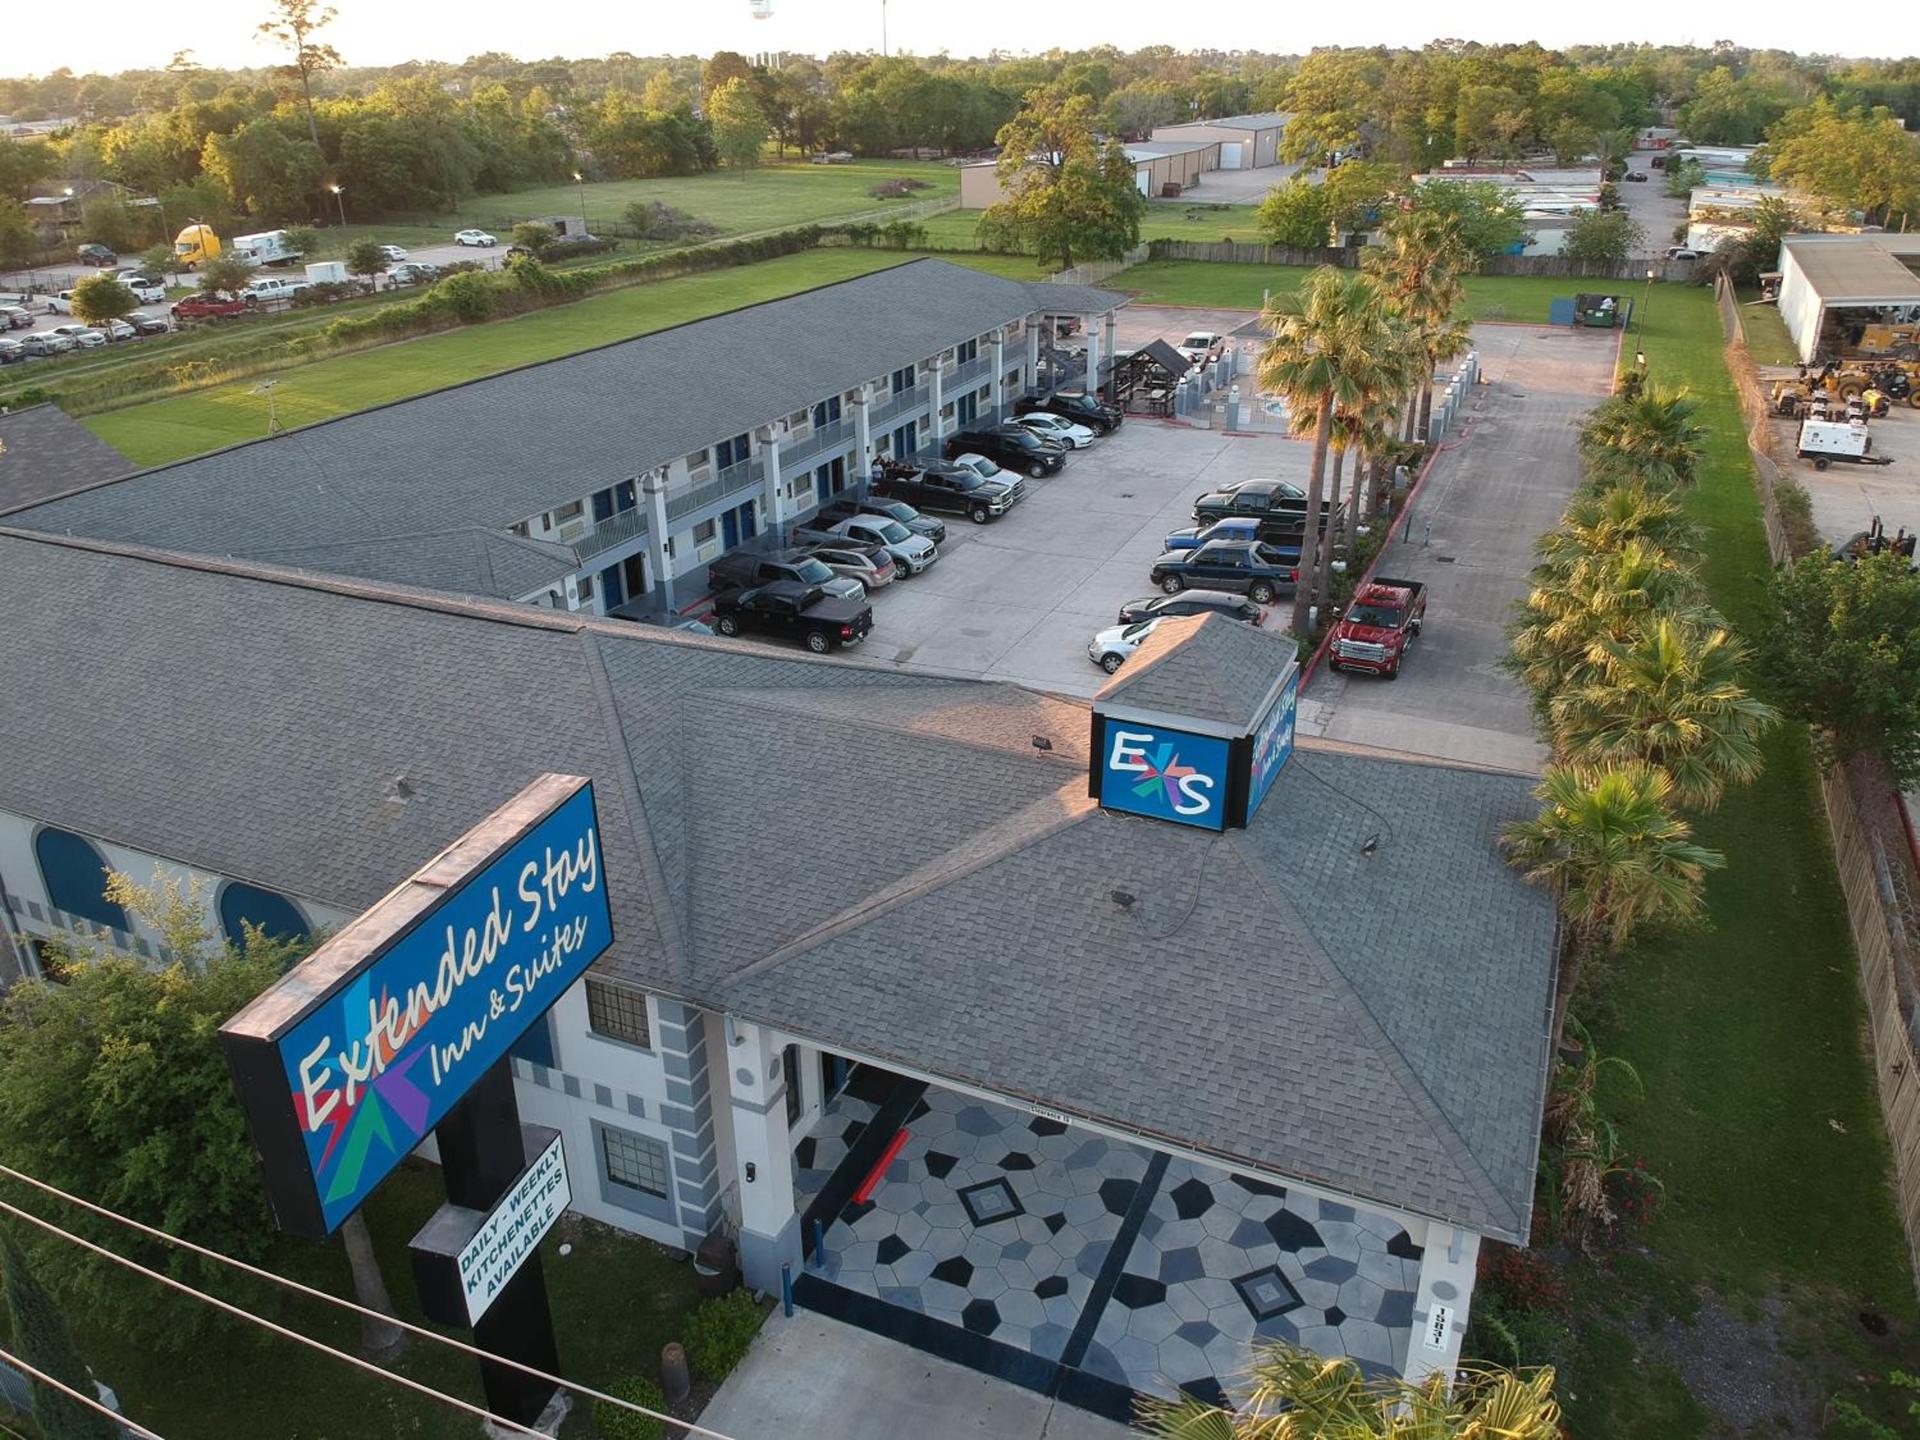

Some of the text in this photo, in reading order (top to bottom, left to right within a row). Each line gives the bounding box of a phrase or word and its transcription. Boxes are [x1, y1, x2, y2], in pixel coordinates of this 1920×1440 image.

[300, 828, 597, 1132] Extended Stay
[430, 915, 588, 1086] Inn & Suites
[462, 1215, 500, 1275] DAILY
[509, 1145, 560, 1213] WEEKLY
[467, 1168, 563, 1295] KITCHENETTES
[487, 1202, 555, 1298] AVAILABLE
